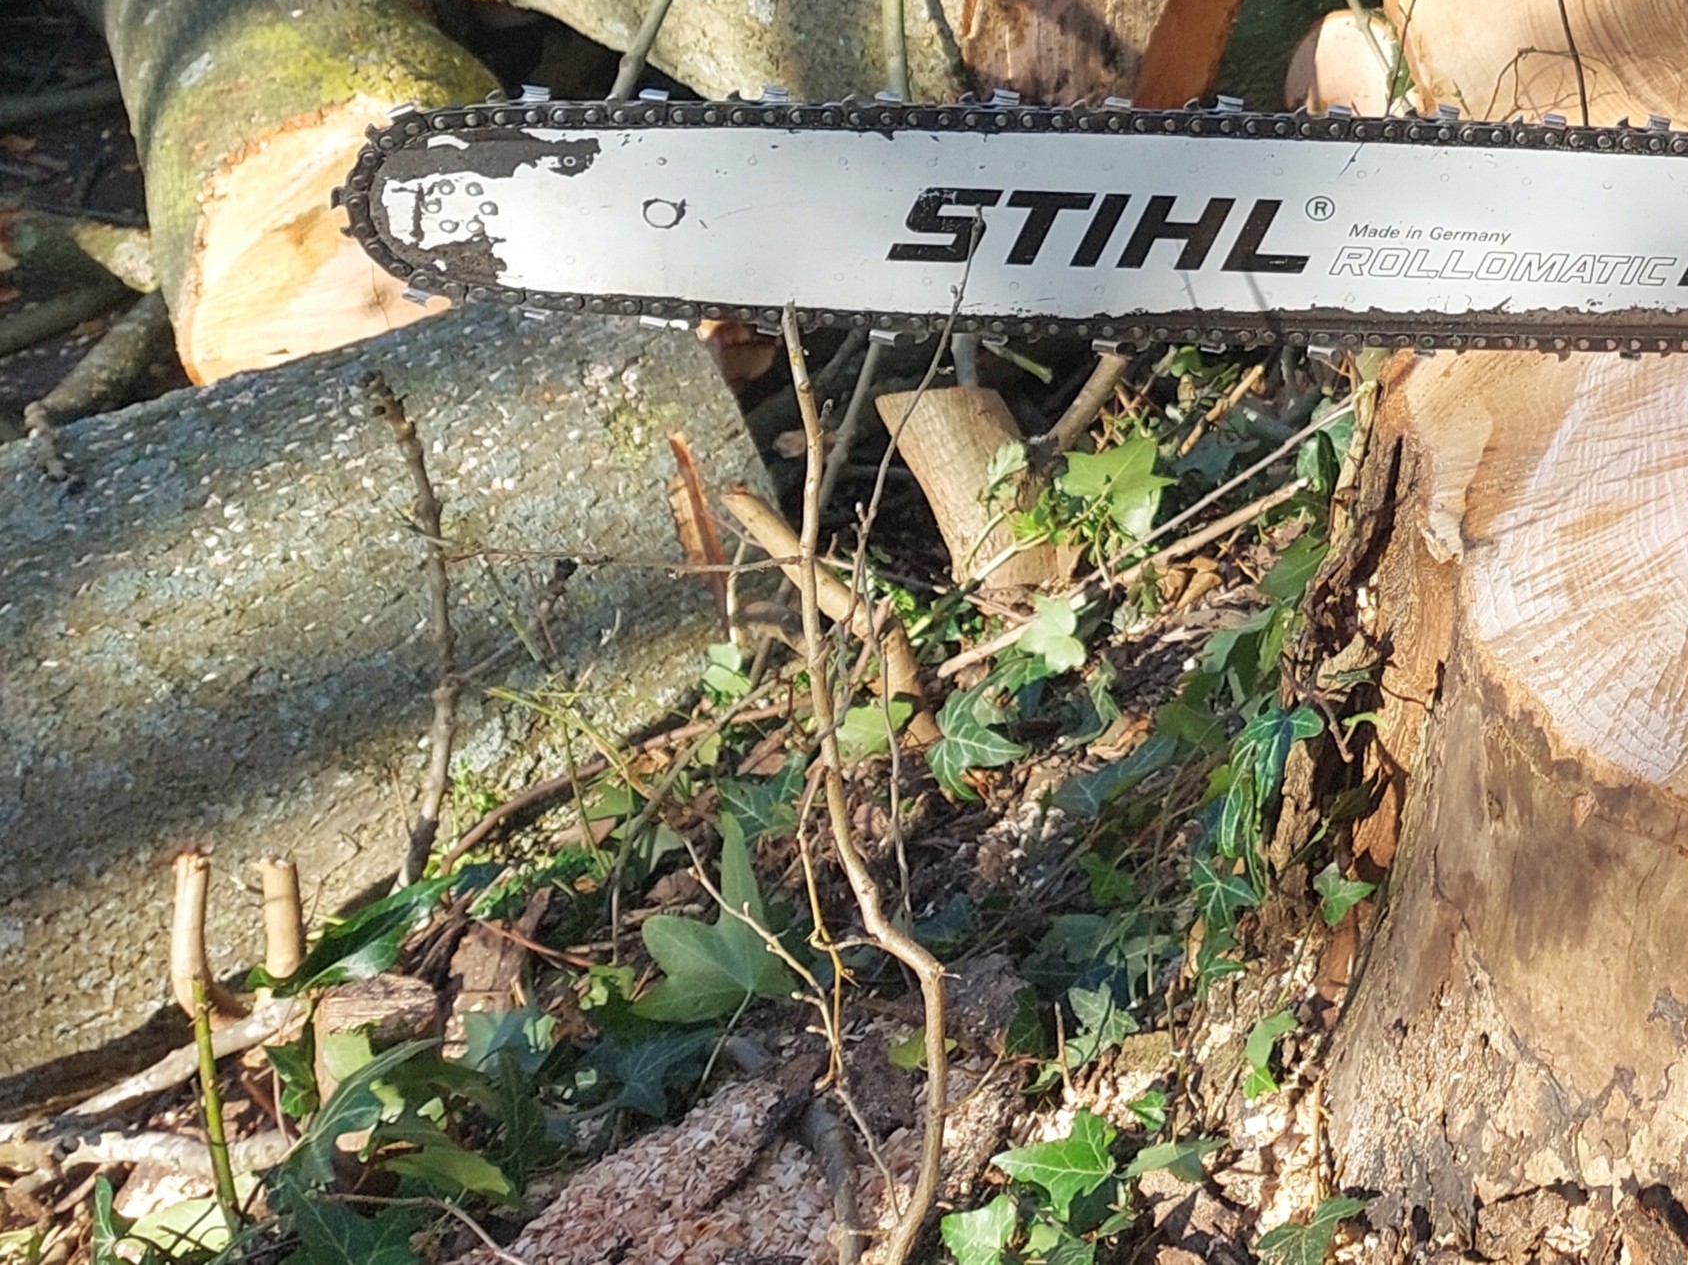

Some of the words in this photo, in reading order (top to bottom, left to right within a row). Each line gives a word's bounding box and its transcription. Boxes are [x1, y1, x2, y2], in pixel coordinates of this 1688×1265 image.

[885, 186, 1311, 274] STIHL
[1348, 223, 1400, 239] Made
[1405, 225, 1423, 240] in
[1429, 226, 1512, 246] Germany
[1329, 246, 1677, 287] ROLLOMATIC
